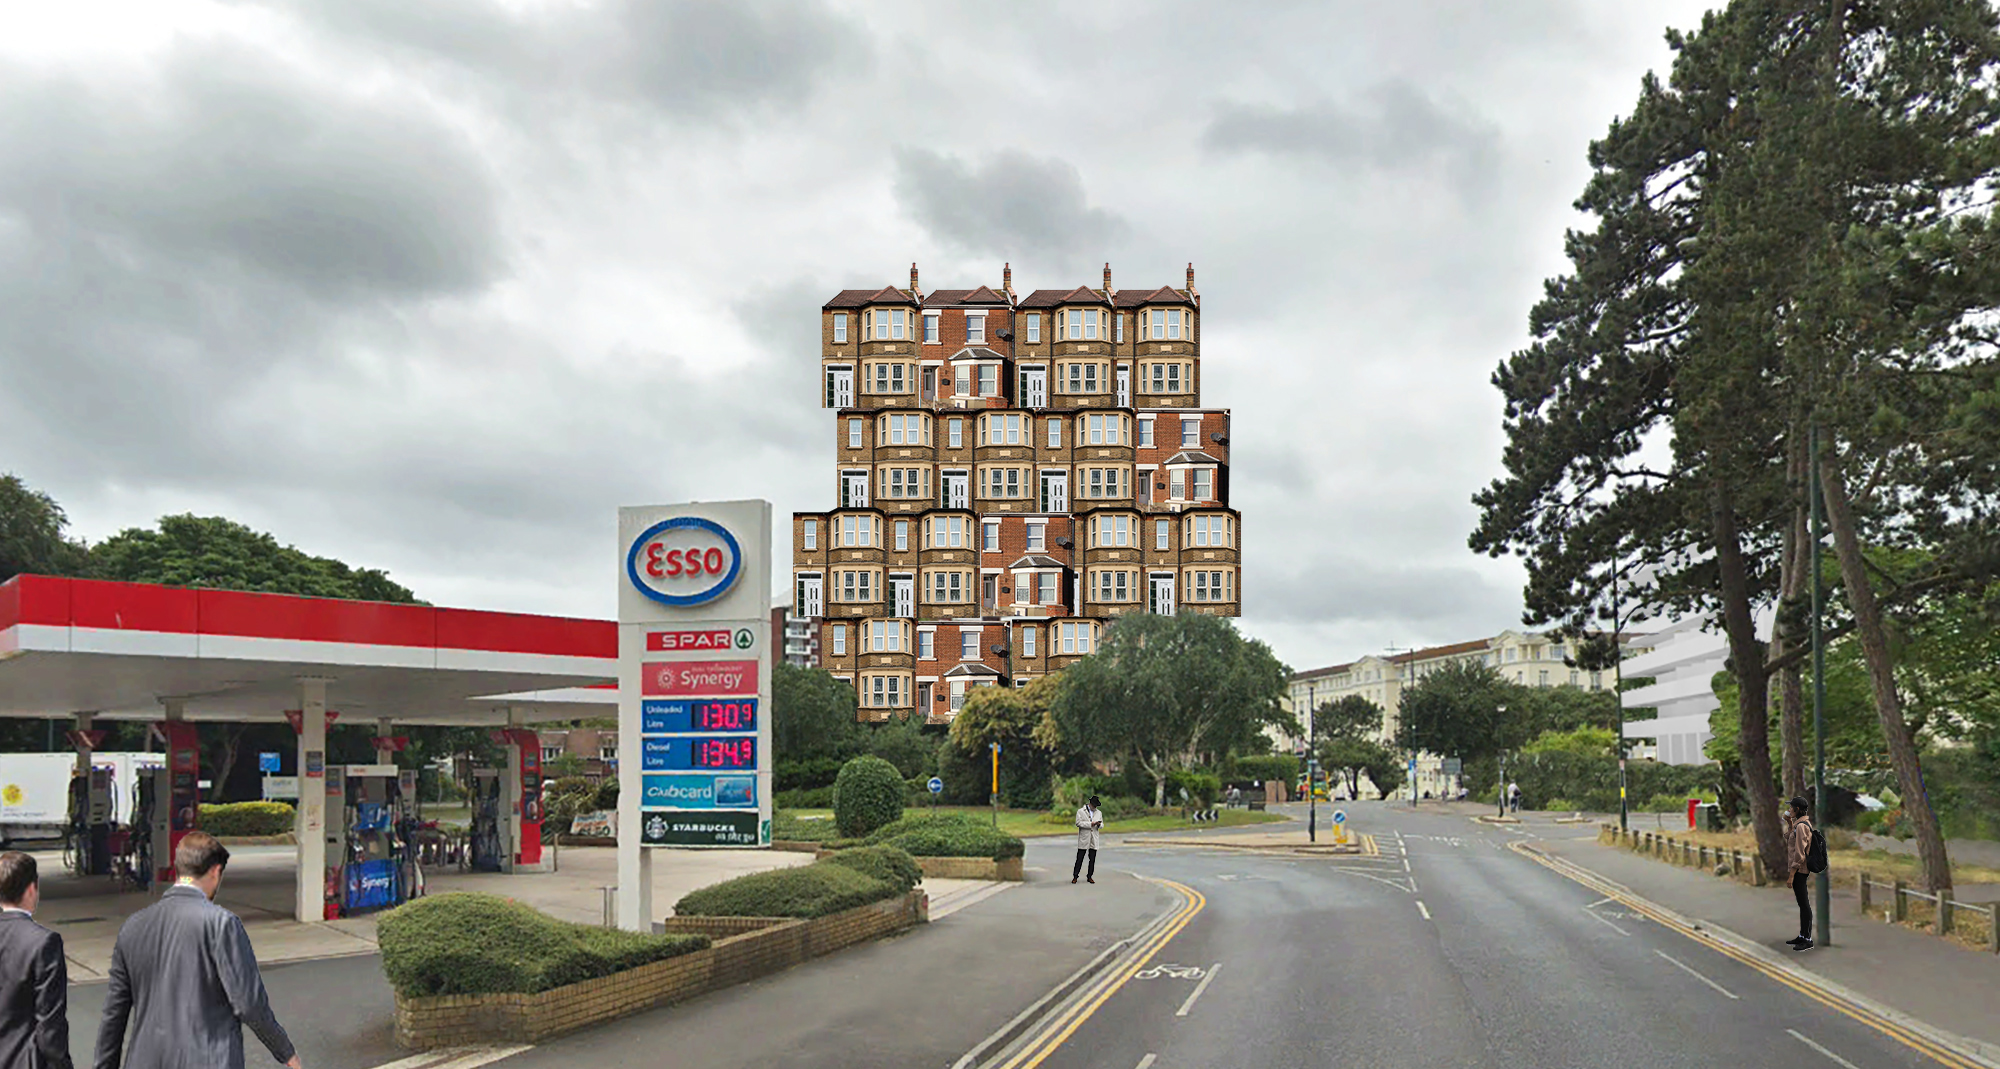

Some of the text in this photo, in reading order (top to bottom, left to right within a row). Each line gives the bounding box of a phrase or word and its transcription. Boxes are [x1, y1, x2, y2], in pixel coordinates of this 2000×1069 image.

[662, 633, 730, 648] SPAR
[680, 670, 743, 688] Synergy
[646, 705, 683, 714] Unleaded
[702, 703, 752, 728] 130.9
[646, 719, 664, 728] Litre
[646, 742, 670, 751] Diesel
[702, 739, 752, 766] 134.9
[646, 757, 664, 766] Litre
[646, 785, 712, 798] Clubcard
[672, 824, 735, 832] STARBUCKS
[715, 831, 755, 843] on the go
